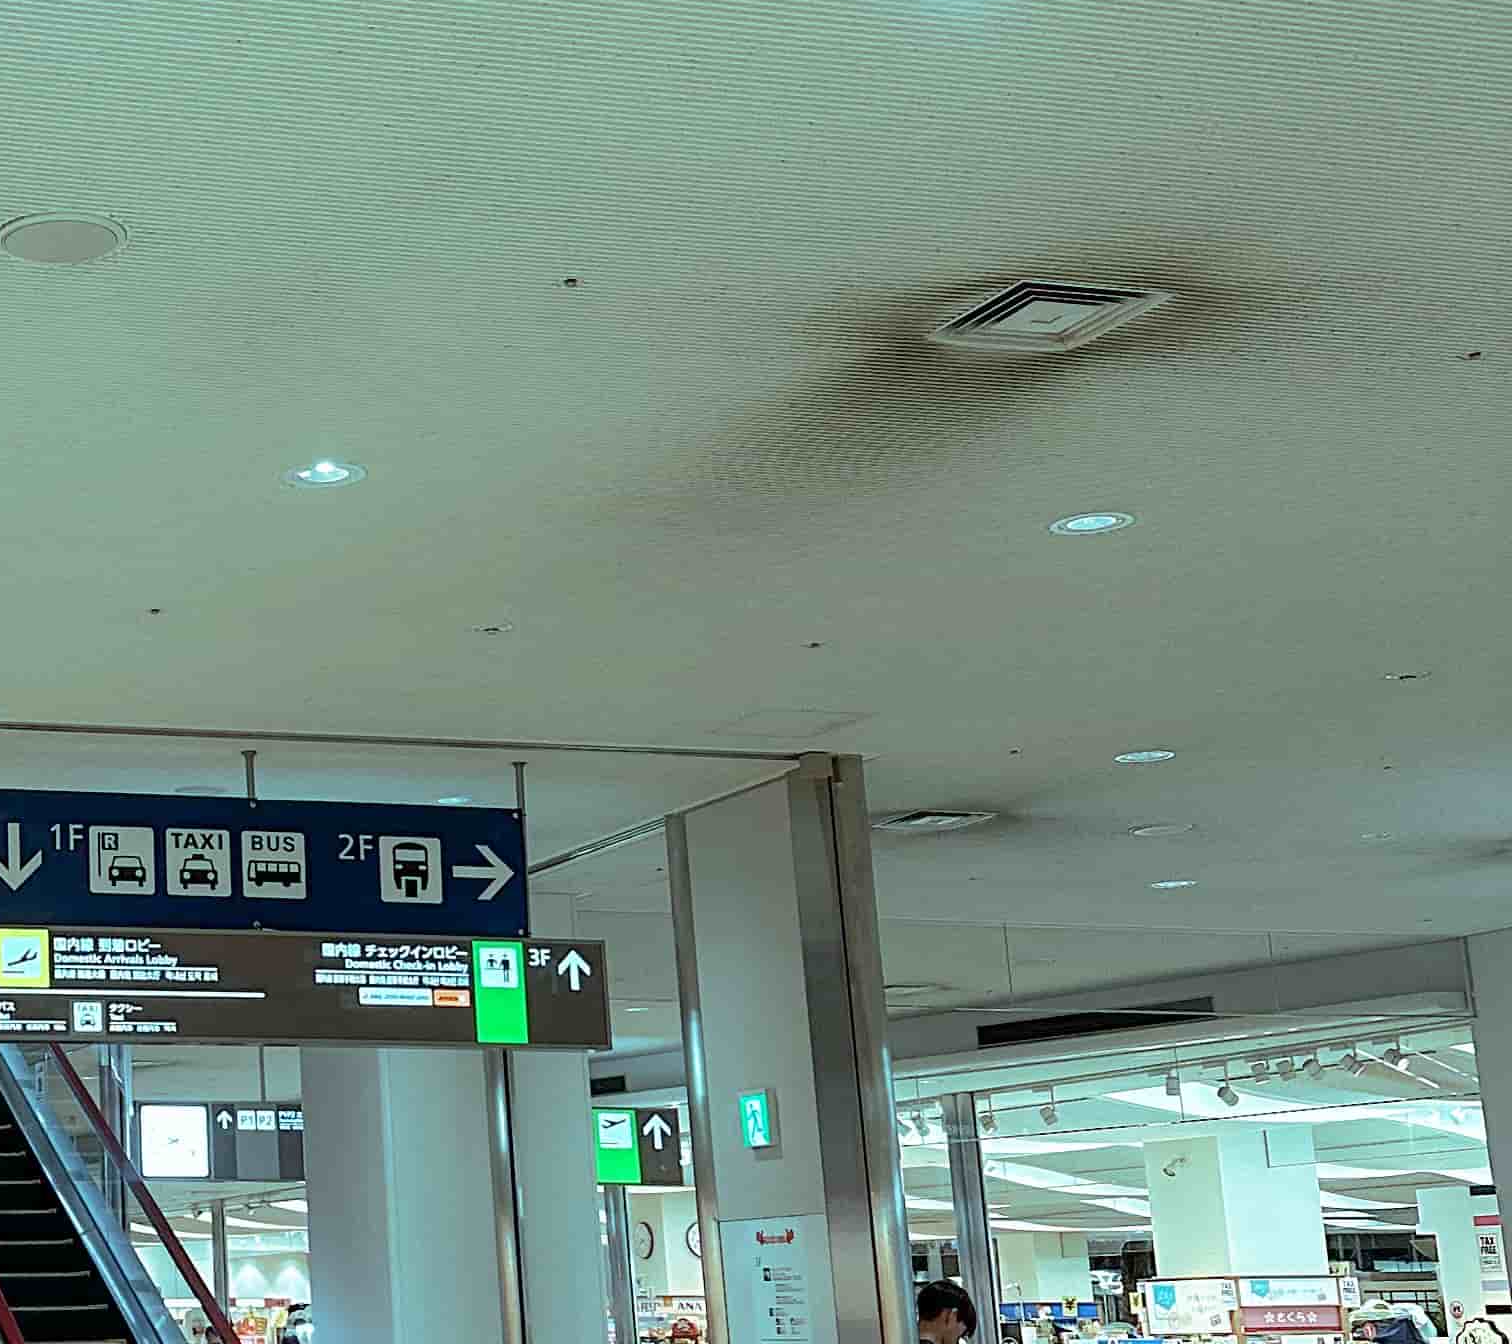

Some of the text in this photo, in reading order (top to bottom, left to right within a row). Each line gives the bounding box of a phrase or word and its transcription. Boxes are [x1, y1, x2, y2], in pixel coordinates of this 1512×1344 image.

[50, 824, 84, 851] 1F
[171, 833, 224, 850] TAXI
[251, 836, 295, 852] BUS
[338, 834, 373, 861] 2F
[365, 944, 468, 959] チェックインロビー
[528, 948, 551, 967] 3F
[146, 955, 178, 967] Lobby
[393, 960, 436, 971] Check-in
[438, 961, 468, 974] Lobby
[240, 1115, 254, 1126] P1
[259, 1115, 273, 1126] P2
[1479, 1236, 1494, 1245] TAX
[678, 1302, 703, 1312] ANA
